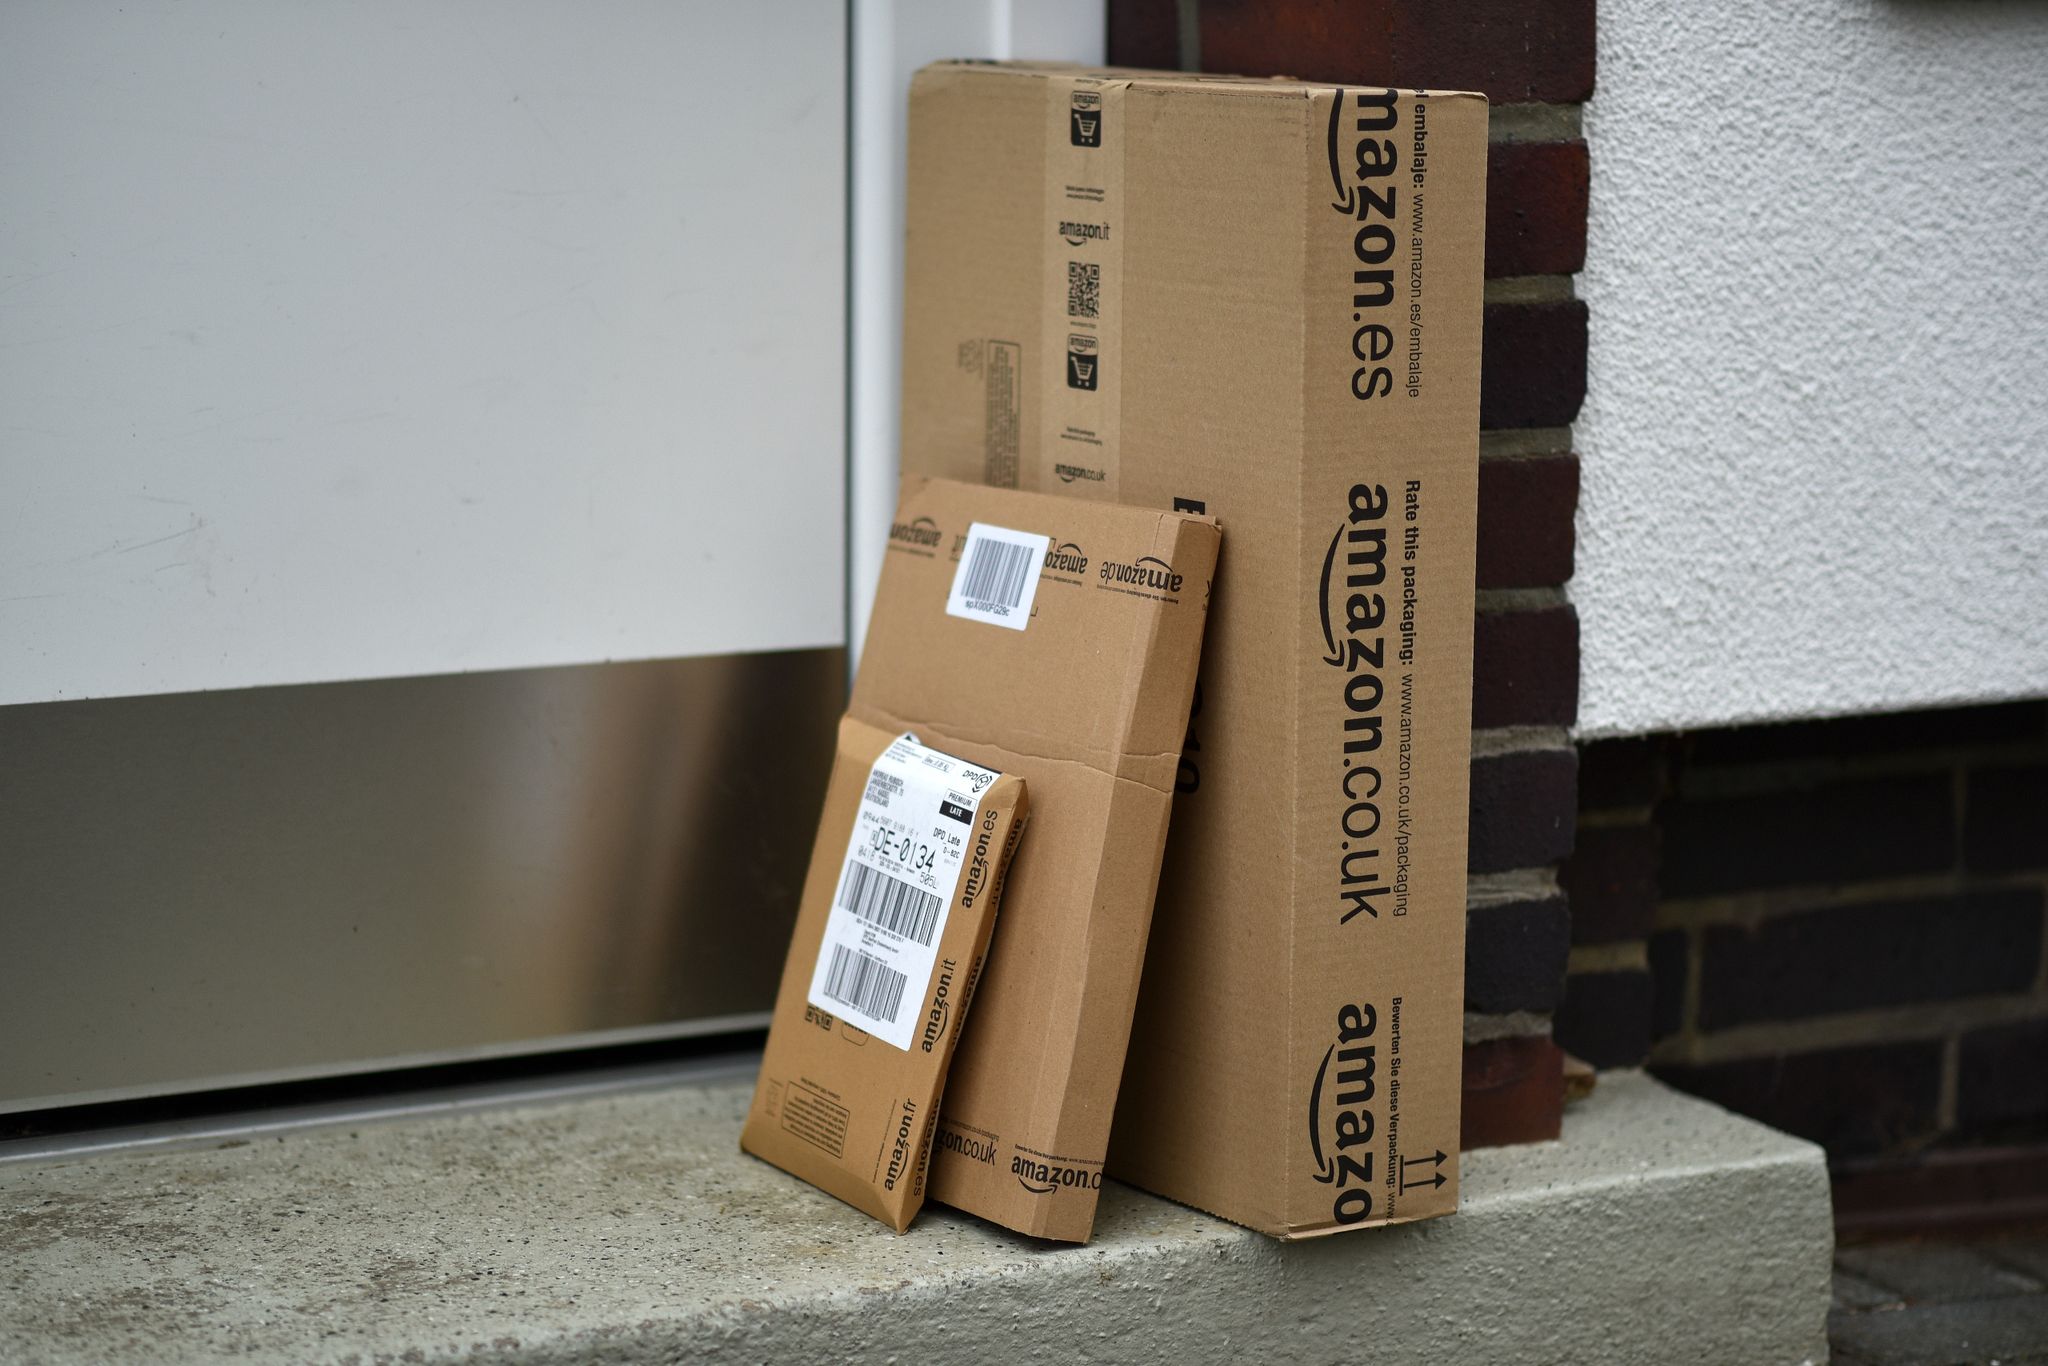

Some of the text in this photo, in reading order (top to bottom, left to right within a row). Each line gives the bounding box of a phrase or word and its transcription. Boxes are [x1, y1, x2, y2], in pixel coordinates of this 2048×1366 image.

[1073, 94, 1099, 104] amazon
[1411, 105, 1429, 188] embalaje:
[1059, 221, 1110, 240] amazon.it
[1406, 194, 1425, 397] www.amazon.es/embalaje
[1070, 337, 1096, 349] amazon
[1055, 463, 1106, 482] amazon.co.uk
[1044, 550, 1088, 574] amazo
[1100, 560, 1183, 593] amazon.de
[1340, 484, 1390, 924] amazon.co.uk
[1394, 481, 1420, 916] Rate this packaging: www.amazon.co.uk/packaging
[962, 769, 979, 782] DPD
[949, 792, 972, 806] PREMIUM
[949, 807, 962, 817] LATE
[875, 827, 934, 872] DE-0134
[962, 809, 998, 909] amazon.es
[921, 958, 957, 1053] amazon.it
[1391, 997, 1402, 1054] Bewerten
[1391, 1059, 1401, 1076] Sie
[1333, 1003, 1377, 1225] amazo
[1390, 1080, 1400, 1111] diese
[884, 1098, 917, 1191] amazon.fr
[1386, 1115, 1399, 1188] Verpackung:
